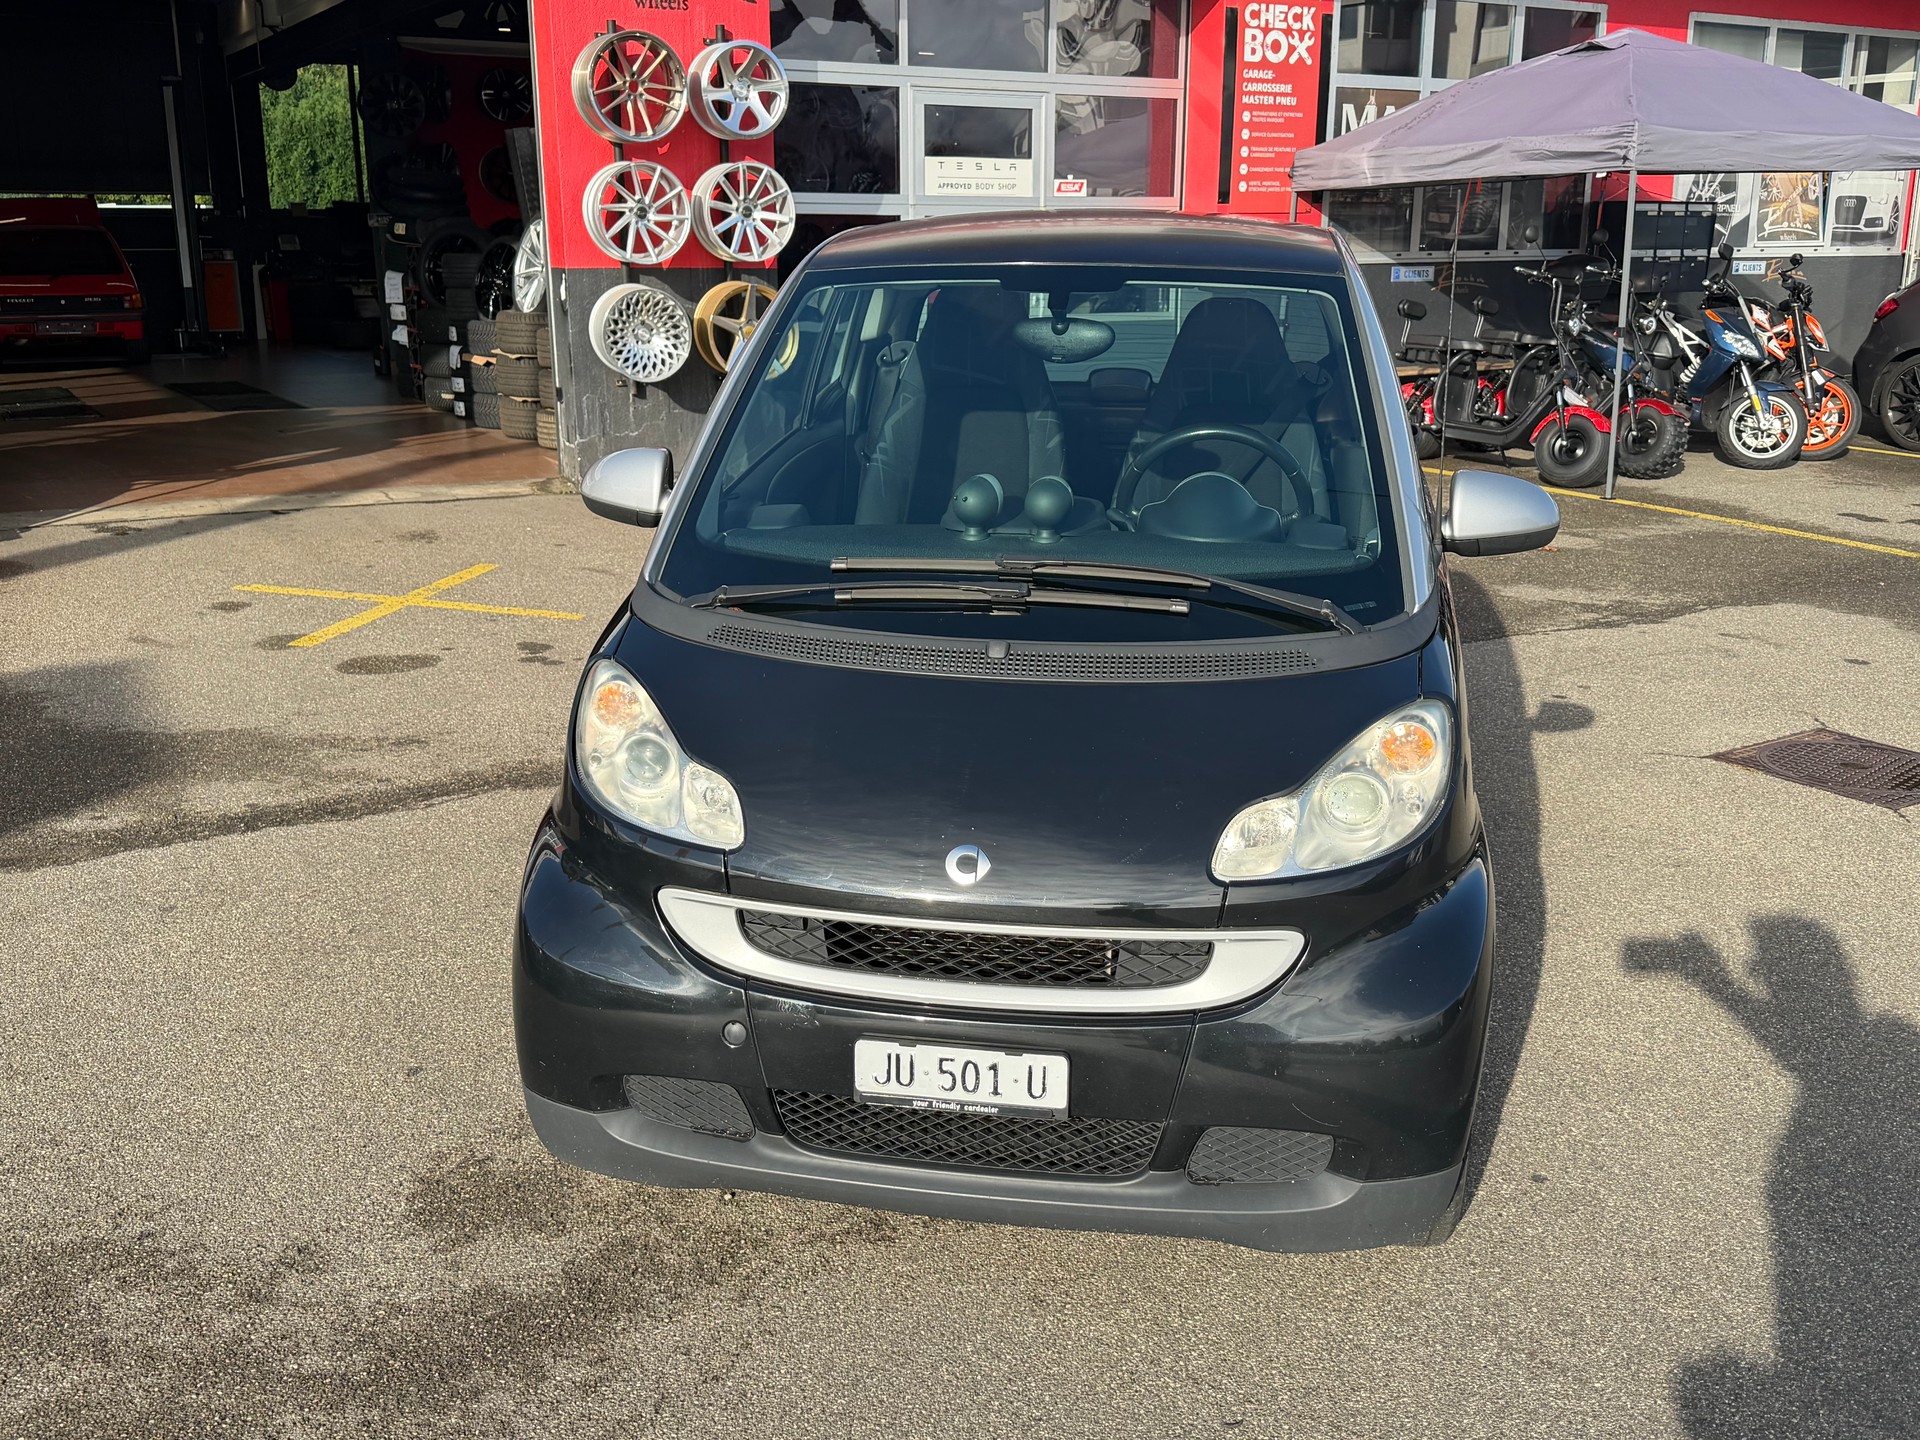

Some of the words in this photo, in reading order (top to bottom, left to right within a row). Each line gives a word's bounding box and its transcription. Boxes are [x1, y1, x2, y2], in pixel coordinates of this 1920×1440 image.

[1244, 2, 1317, 31] CHECK
[1243, 28, 1315, 65] BOX
[1242, 69, 1276, 79] GARAGE-
[1242, 82, 1293, 93] CARROSSERIE
[1241, 95, 1274, 105] MASTER
[1275, 96, 1297, 106] PNEU
[937, 161, 1017, 171] TESLA
[937, 182, 972, 190] APPROVED
[975, 182, 995, 190] BODY
[997, 182, 1017, 190] SHOP
[1716, 203, 1741, 213] RPNEU
[1742, 263, 1762, 272] CLIENTS
[1403, 269, 1430, 279] CLIENTS
[872, 1051, 916, 1088] JU
[936, 1056, 1003, 1098] 501
[1026, 1064, 1049, 1100] U
[912, 1099, 931, 1109] your
[932, 1099, 961, 1112] friendly
[964, 1103, 999, 1114] cardealer
